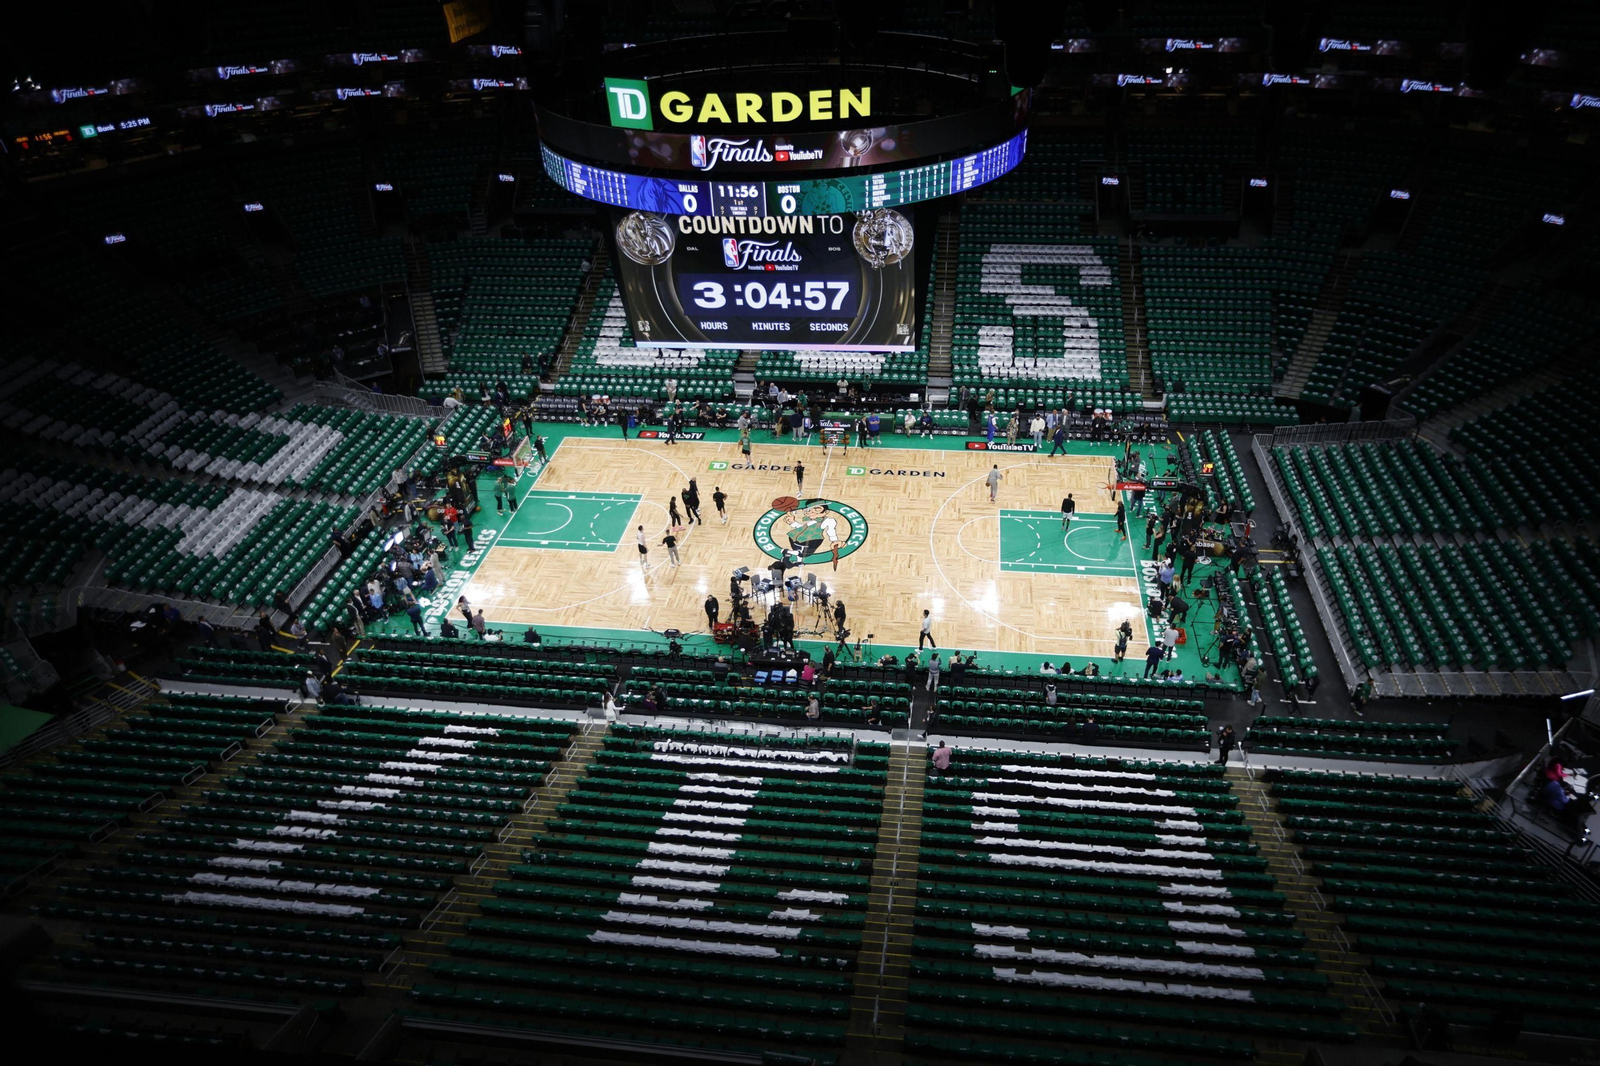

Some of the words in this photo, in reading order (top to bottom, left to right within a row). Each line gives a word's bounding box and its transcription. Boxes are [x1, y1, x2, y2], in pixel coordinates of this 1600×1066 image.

[609, 86, 647, 120] TD
[660, 87, 871, 123] GARDEN
[97, 124, 115, 133] Bank
[120, 120, 137, 129] 5:25
[138, 117, 150, 126] PM
[700, 138, 773, 171] Finals
[678, 184, 698, 193] DALLAS
[718, 185, 758, 198] 11:56
[777, 185, 800, 193] BOSTON
[683, 194, 697, 213] 0
[781, 195, 796, 214] 0
[678, 215, 814, 234] COUNTDOWN
[816, 215, 844, 234] TO
[733, 240, 802, 270] Finals
[700, 321, 728, 331] HOURS
[752, 322, 790, 331] MINUTES
[809, 322, 848, 332] SECONDS
[732, 462, 794, 472] GARDE
[869, 468, 945, 478] GARDEN
[756, 511, 780, 552] BOSTON
[839, 506, 865, 547] CELTICS
[460, 529, 497, 567] CELTICS
